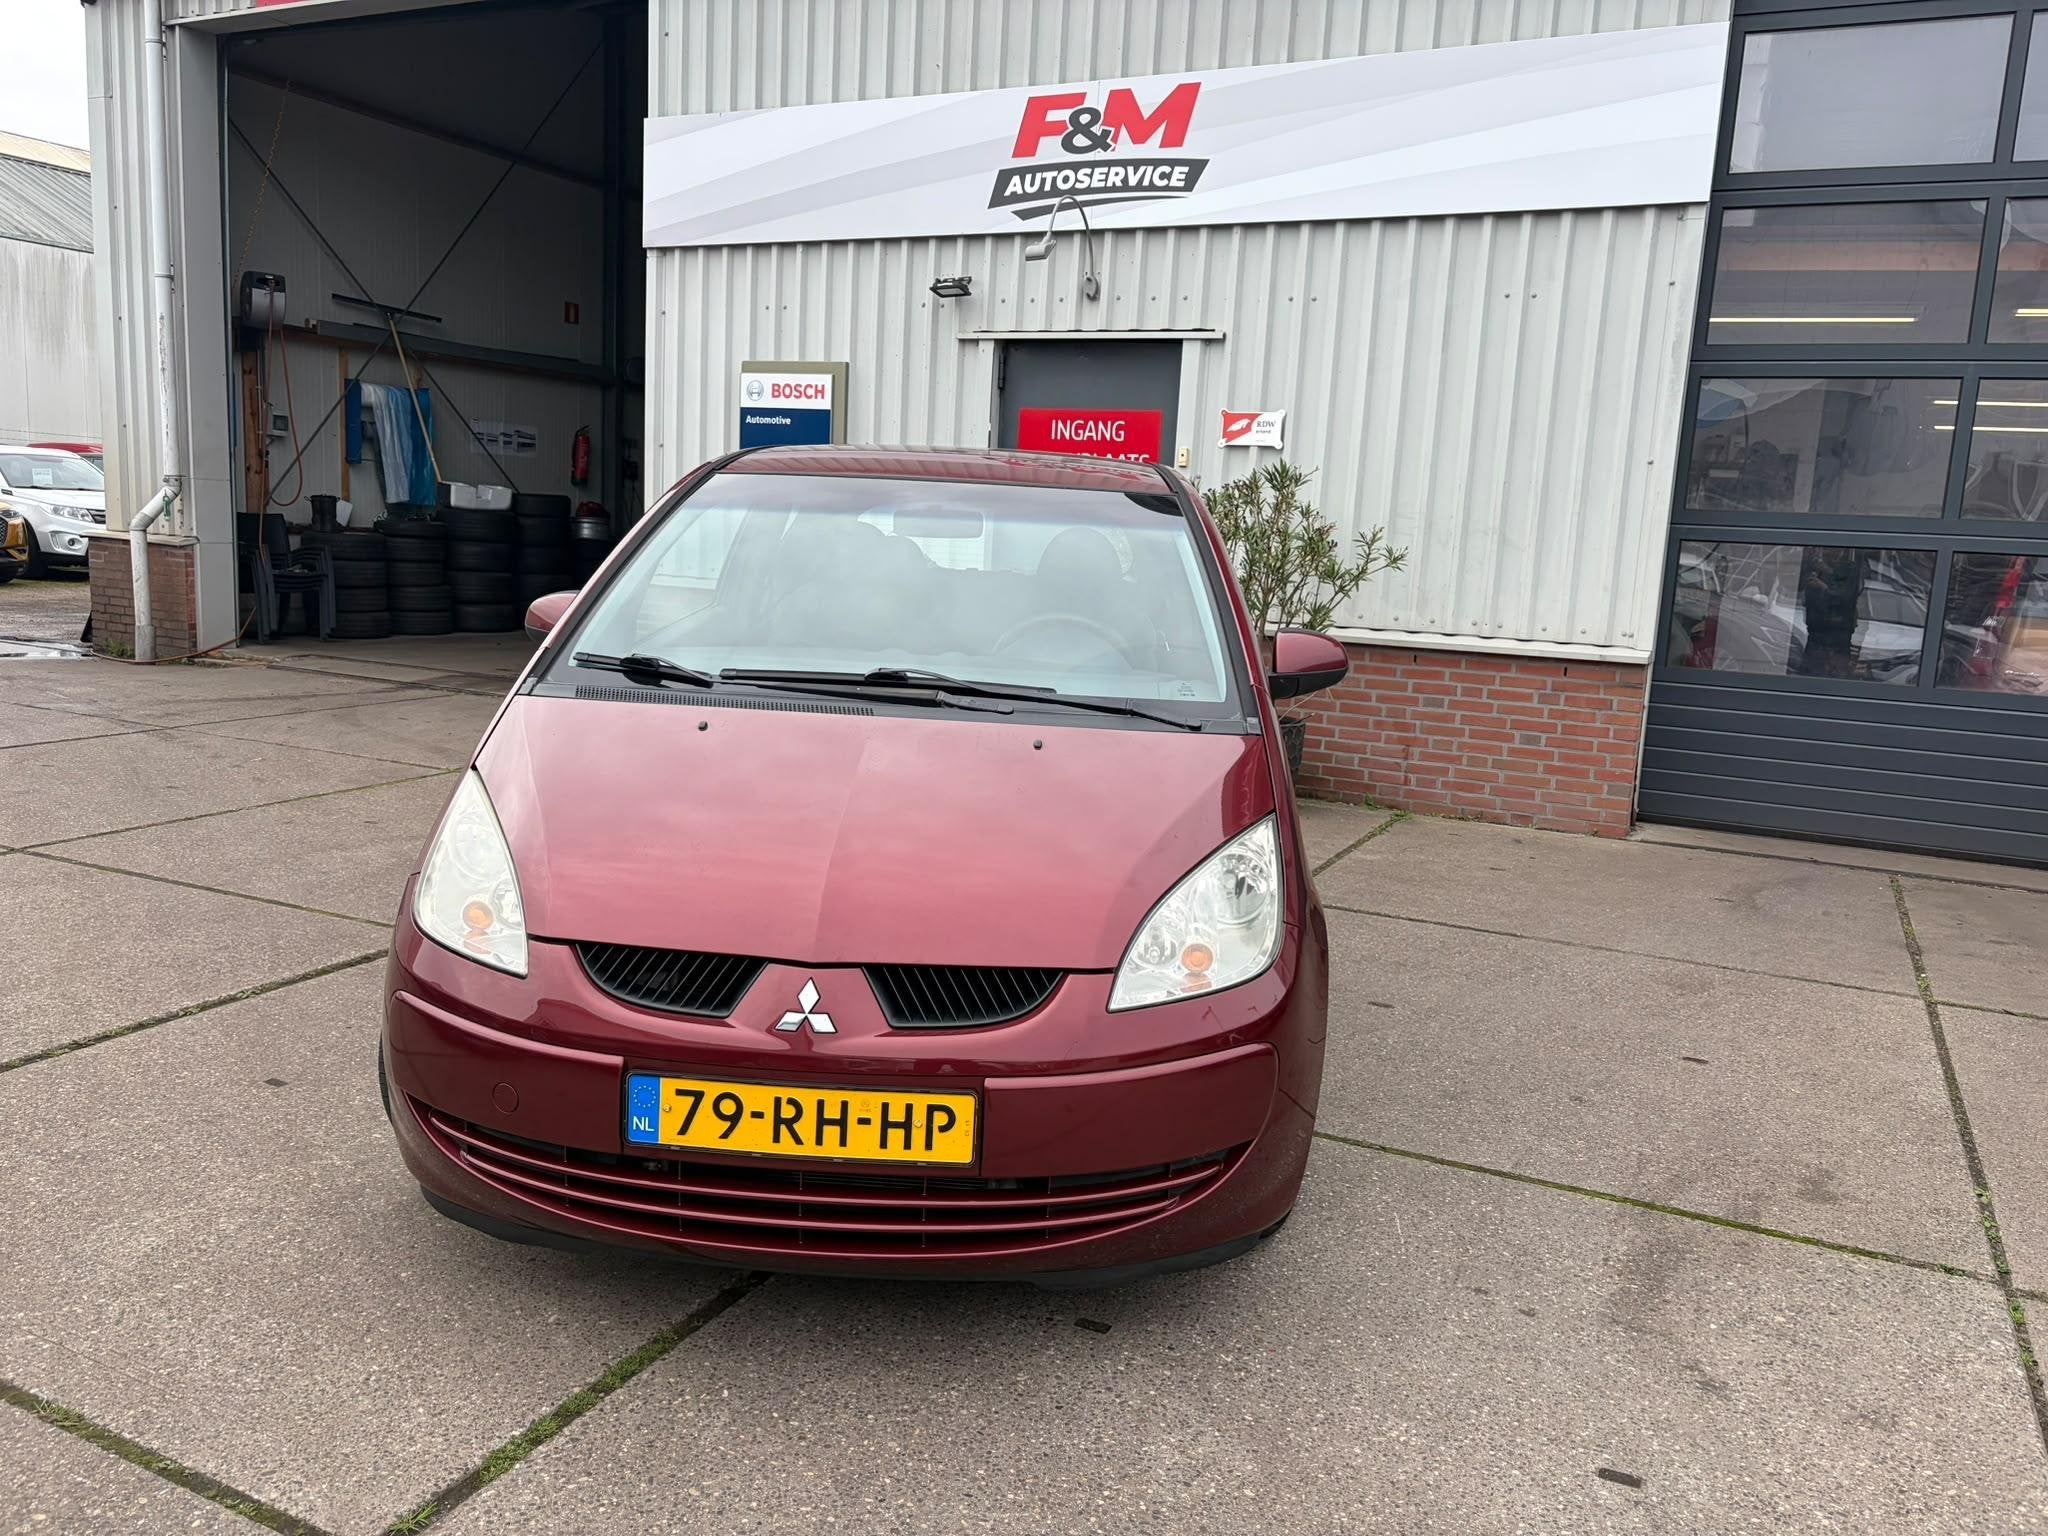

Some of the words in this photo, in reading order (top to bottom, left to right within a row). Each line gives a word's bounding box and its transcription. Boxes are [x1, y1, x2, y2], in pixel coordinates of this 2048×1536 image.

[1011, 82, 1201, 158] F&M
[1004, 165, 1189, 196] AUTOSERVICE
[771, 383, 825, 399] BOSCH
[745, 415, 791, 425] Automotive
[1051, 419, 1125, 441] INGANG
[633, 1115, 655, 1132] NL
[674, 1088, 957, 1151] 79-RH-HP
